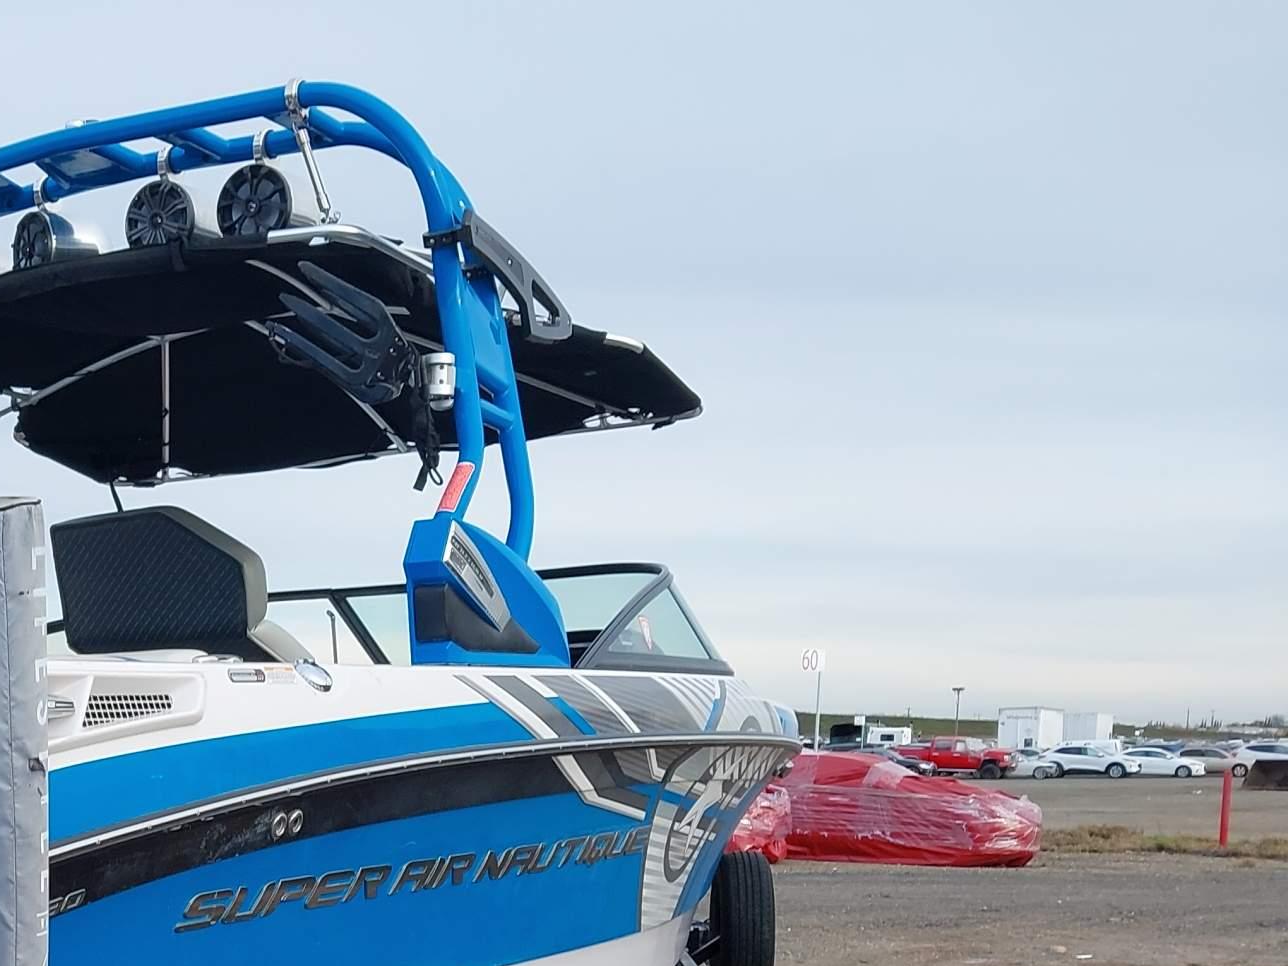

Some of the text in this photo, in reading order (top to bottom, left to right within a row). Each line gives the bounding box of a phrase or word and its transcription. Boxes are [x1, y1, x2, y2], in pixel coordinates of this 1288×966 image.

[802, 649, 818, 671] 60
[174, 825, 650, 933] SUPER AIR NAUTIQUE
